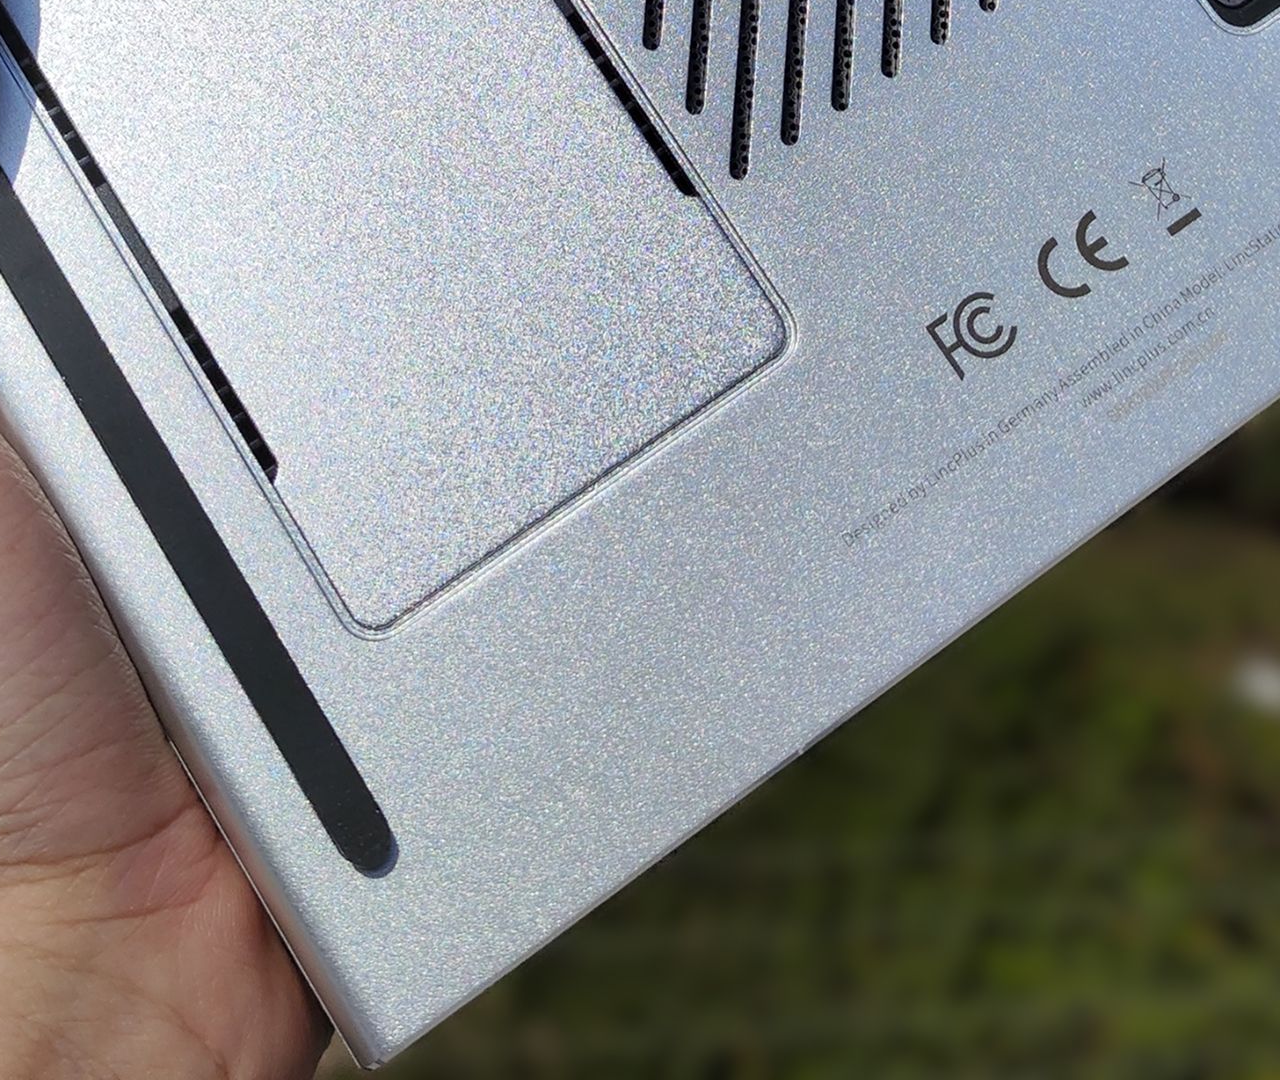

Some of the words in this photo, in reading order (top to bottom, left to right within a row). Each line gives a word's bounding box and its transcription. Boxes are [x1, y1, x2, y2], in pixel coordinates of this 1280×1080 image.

[1038, 209, 1130, 298] CE
[926, 291, 1017, 381] FCC
[1079, 306, 1215, 409] www.lincplus.com.cn
[842, 492, 909, 548] Designed
[924, 442, 985, 487] LincPlus
[983, 428, 999, 447] in
[997, 387, 1060, 435] Germany
[1058, 333, 1131, 393] Assembled
[1127, 325, 1145, 341] in
[1142, 298, 1183, 330] China
